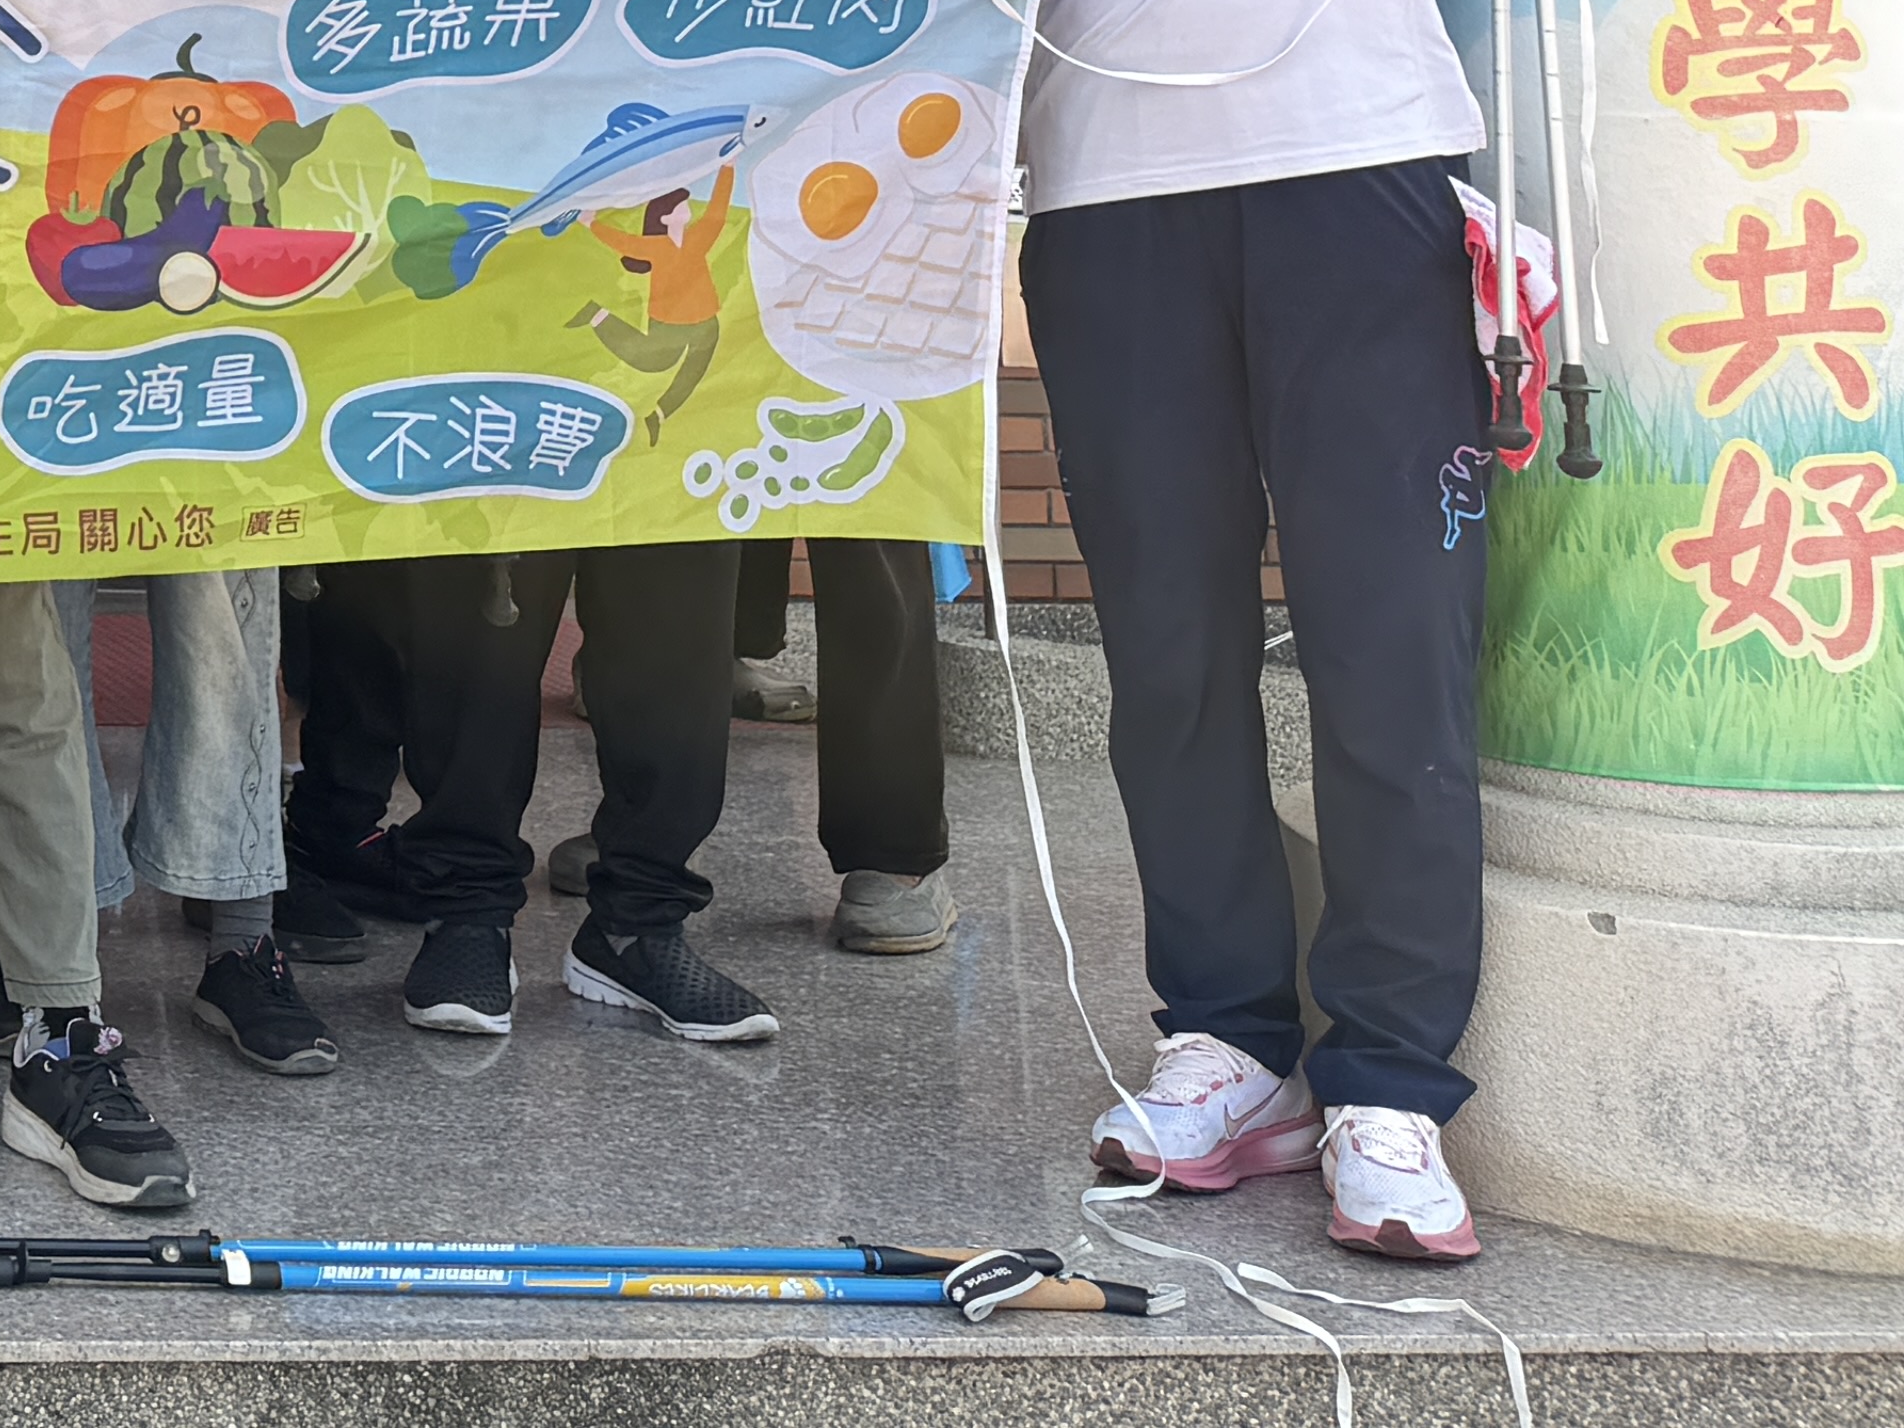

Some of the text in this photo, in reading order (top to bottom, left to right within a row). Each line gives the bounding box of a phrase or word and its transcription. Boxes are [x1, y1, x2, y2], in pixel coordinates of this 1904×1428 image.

[28, 353, 266, 447] 吃適量
[368, 396, 602, 478] 不浪費
[78, 504, 216, 558] 關心您
